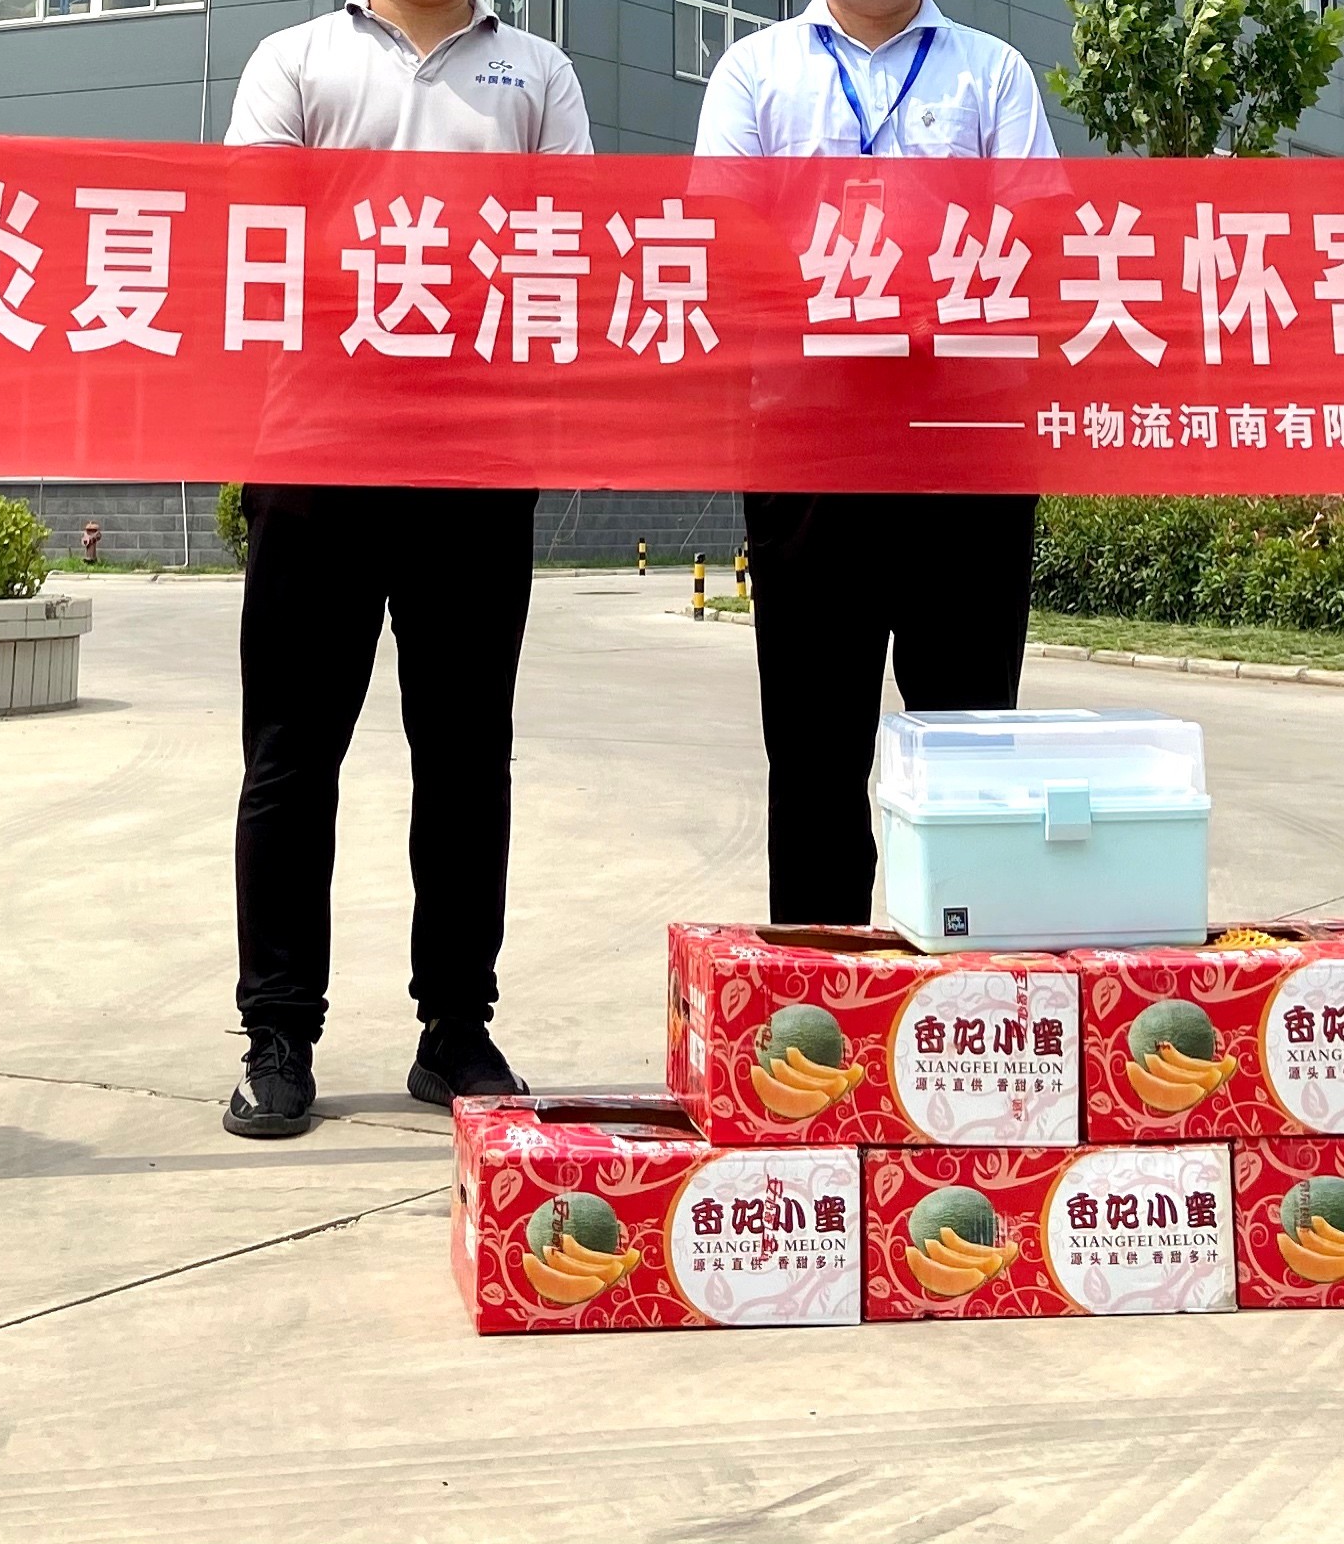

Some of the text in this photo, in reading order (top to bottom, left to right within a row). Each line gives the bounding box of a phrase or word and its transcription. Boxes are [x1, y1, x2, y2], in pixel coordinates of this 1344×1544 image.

[475, 74, 525, 88] 中国物流
[914, 1015, 1063, 1057] 香妃小蜜
[915, 1060, 1064, 1075] XIANGFEI MELON
[916, 1077, 1063, 1093] 源头直供 香甜多汁
[691, 1195, 846, 1235] 香妃小蜜
[1066, 1191, 1217, 1230] 香妃小蜜
[784, 1238, 847, 1252] MELON
[1069, 1233, 1219, 1248] XIANGFEI MELON
[693, 1255, 846, 1272] 源头直供 香甜多汁
[1070, 1250, 1219, 1266] 源头直供 香甜多汁
